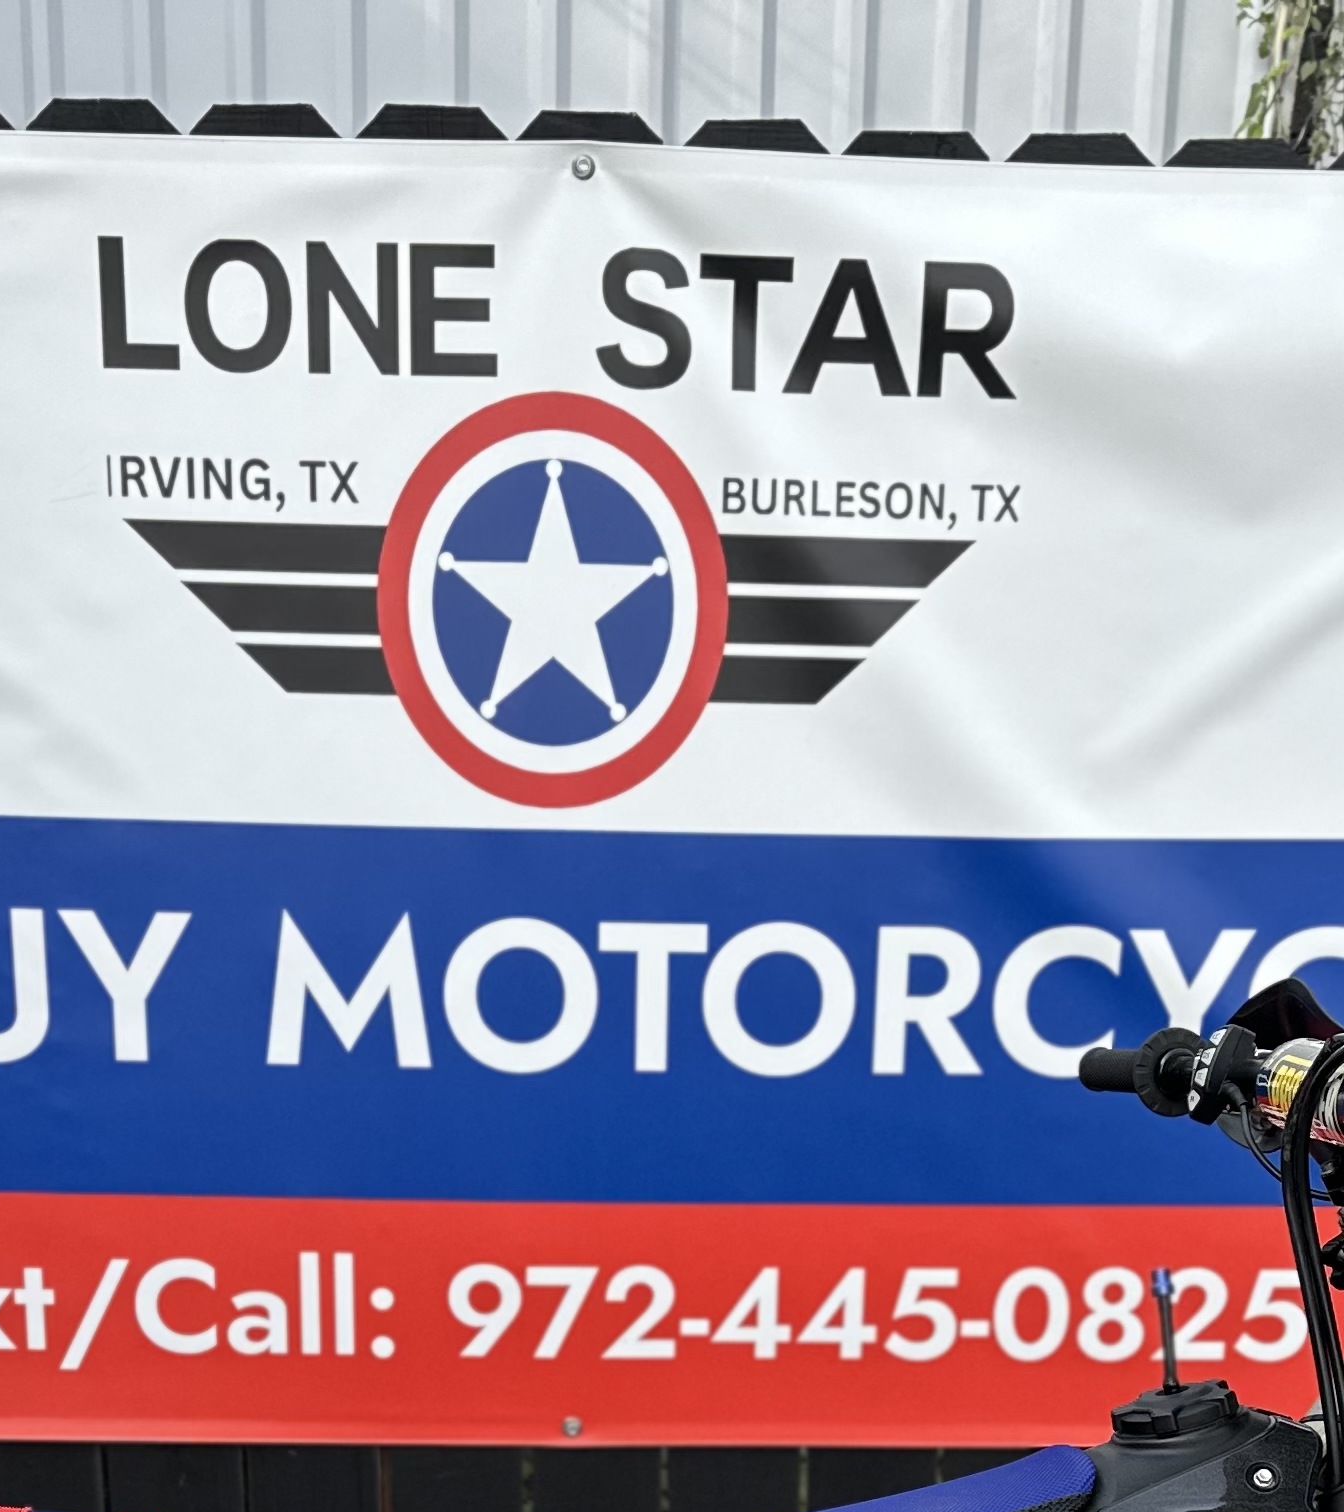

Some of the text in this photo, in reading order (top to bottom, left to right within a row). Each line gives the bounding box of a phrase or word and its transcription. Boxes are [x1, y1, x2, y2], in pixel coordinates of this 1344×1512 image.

[97, 235, 1017, 400] LONE STAR
[106, 454, 359, 513] IRVING, TX
[721, 477, 1021, 530] BURLESON, TX
[446, 1262, 1310, 1362] 972-445-0825
